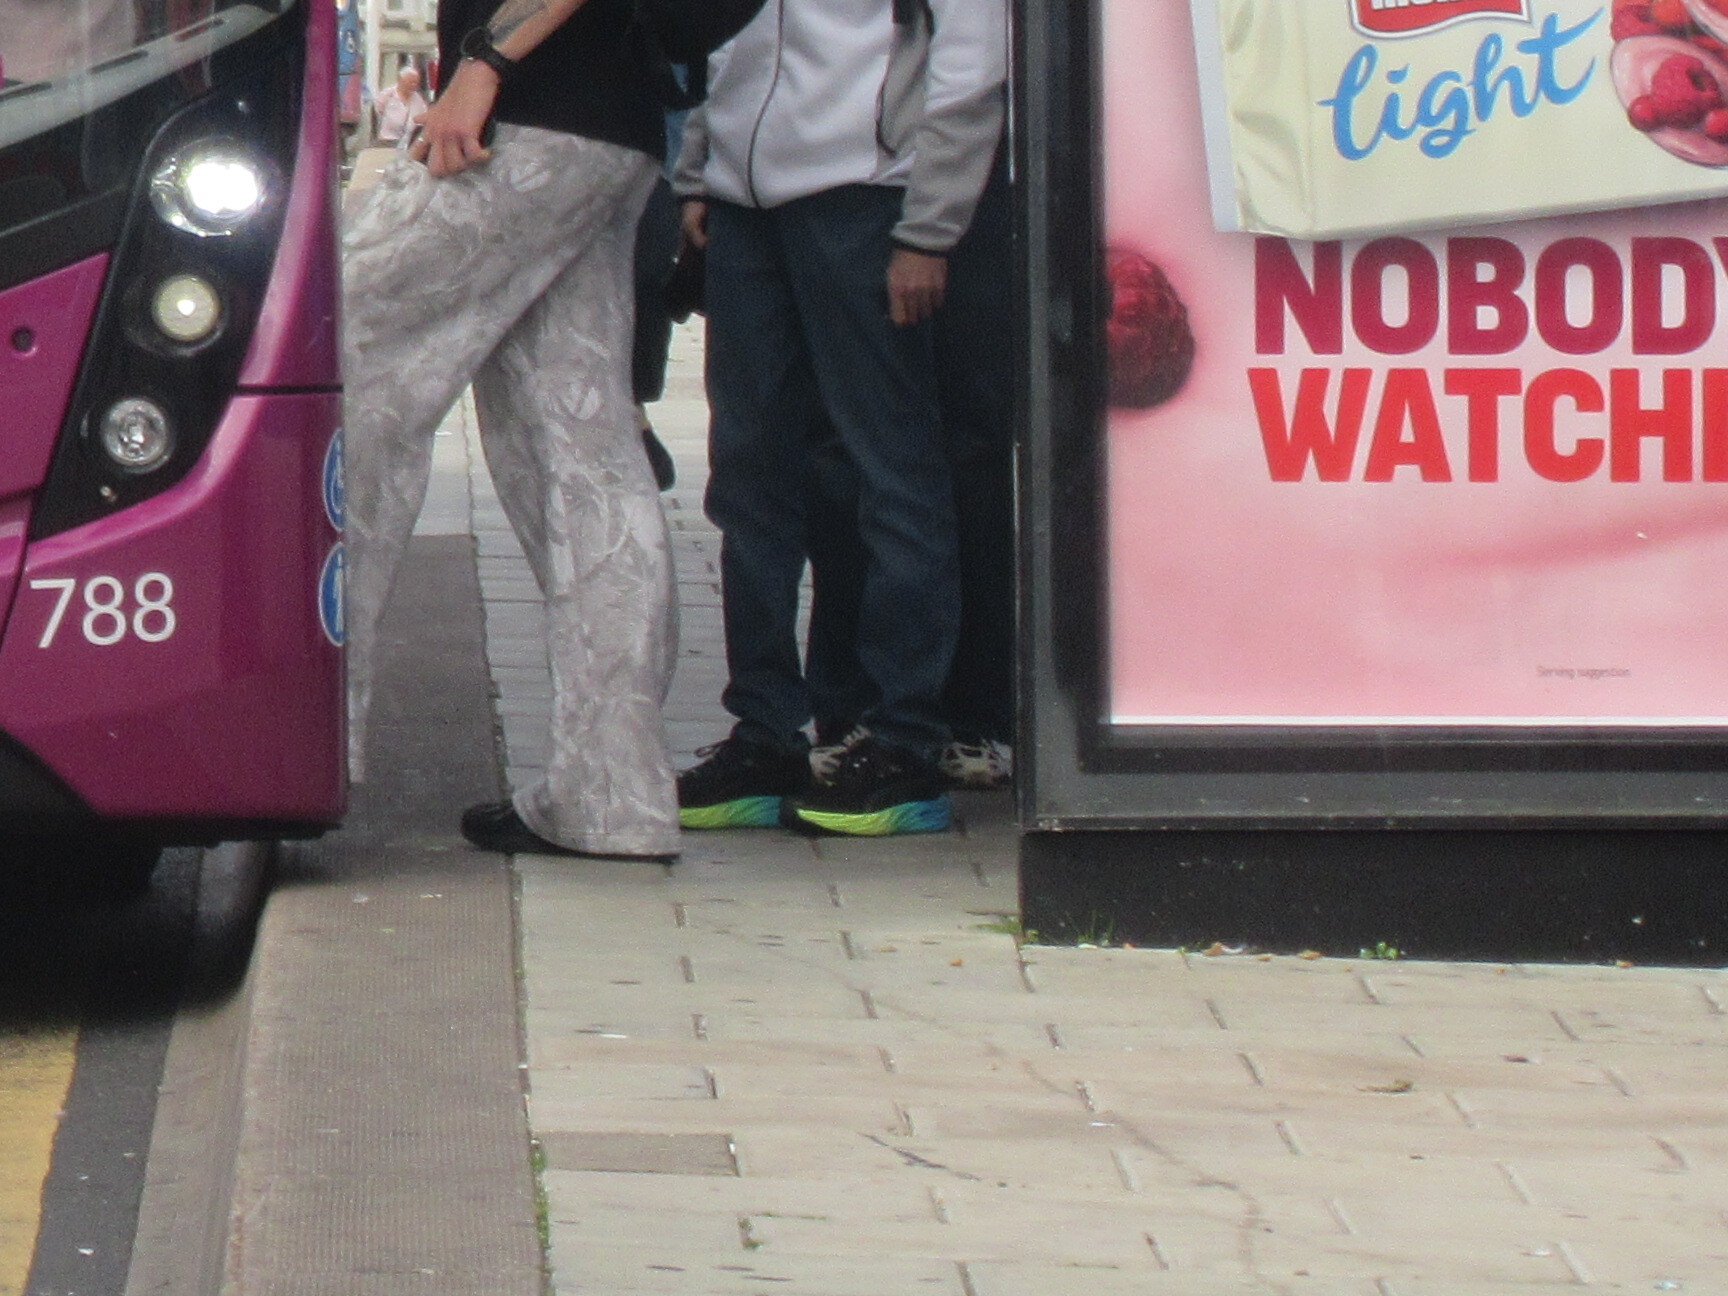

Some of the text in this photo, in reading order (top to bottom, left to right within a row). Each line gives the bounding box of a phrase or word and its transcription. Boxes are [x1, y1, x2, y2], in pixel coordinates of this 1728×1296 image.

[1316, 5, 1606, 162] light
[1254, 237, 1728, 356] NOBOD
[28, 570, 178, 650] 788
